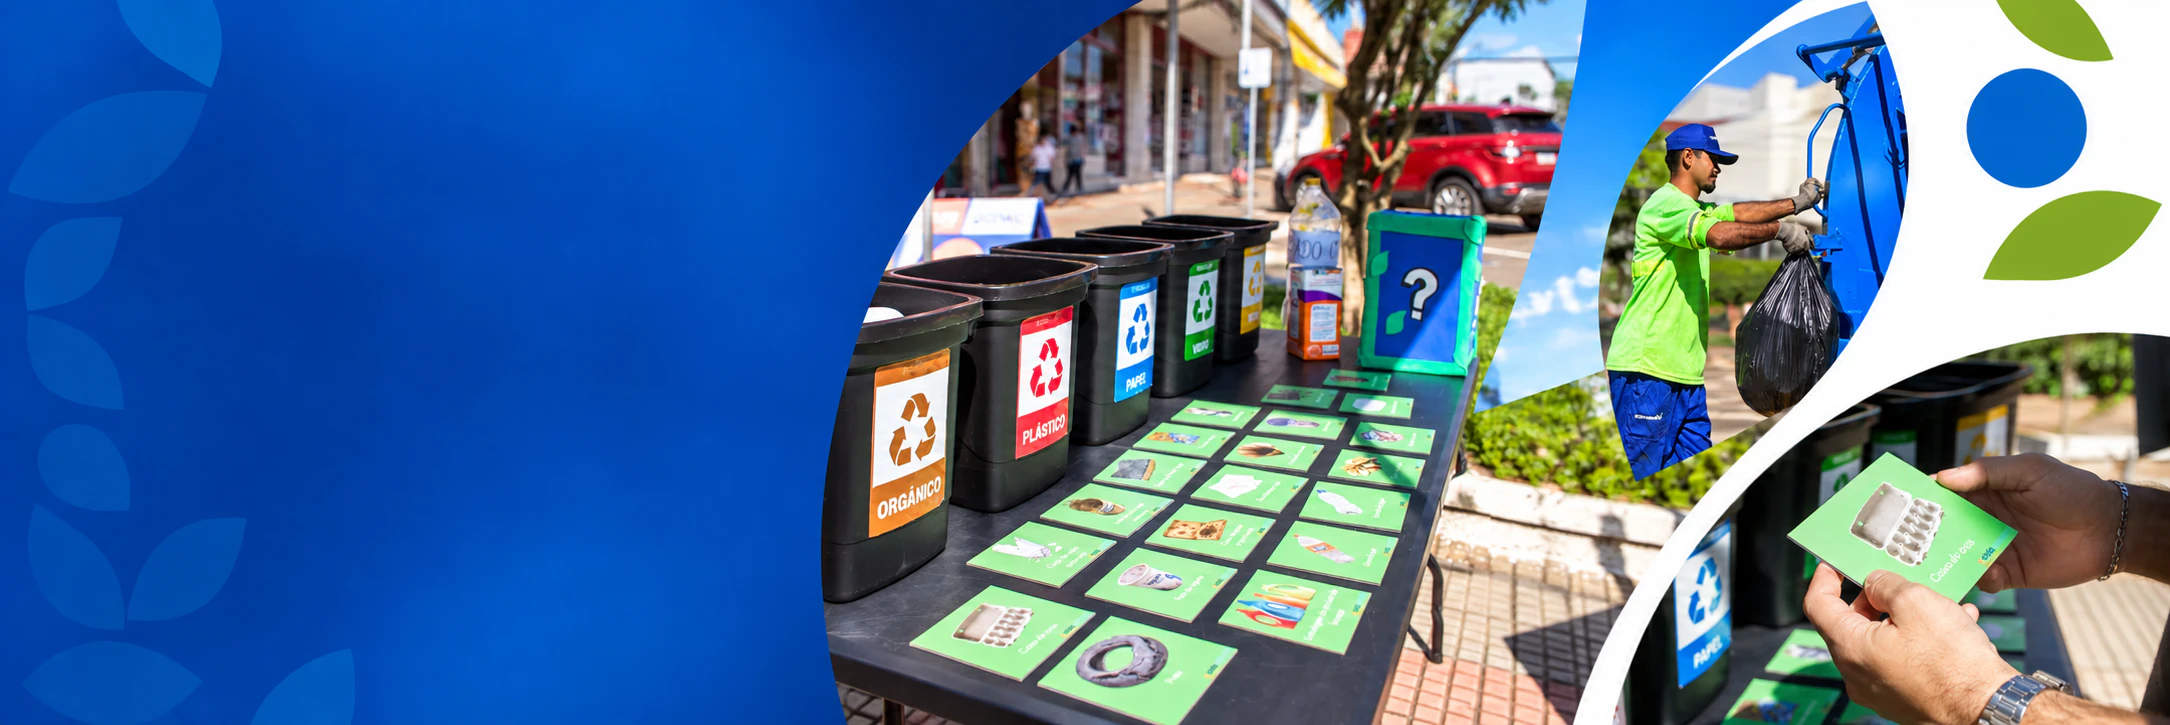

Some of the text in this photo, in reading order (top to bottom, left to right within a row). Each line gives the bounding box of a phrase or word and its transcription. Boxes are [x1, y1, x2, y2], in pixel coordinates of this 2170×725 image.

[1125, 371, 1147, 393] PAPEL
[1022, 413, 1066, 446] PLÁSTICO
[1693, 634, 1723, 669] PAPEL
